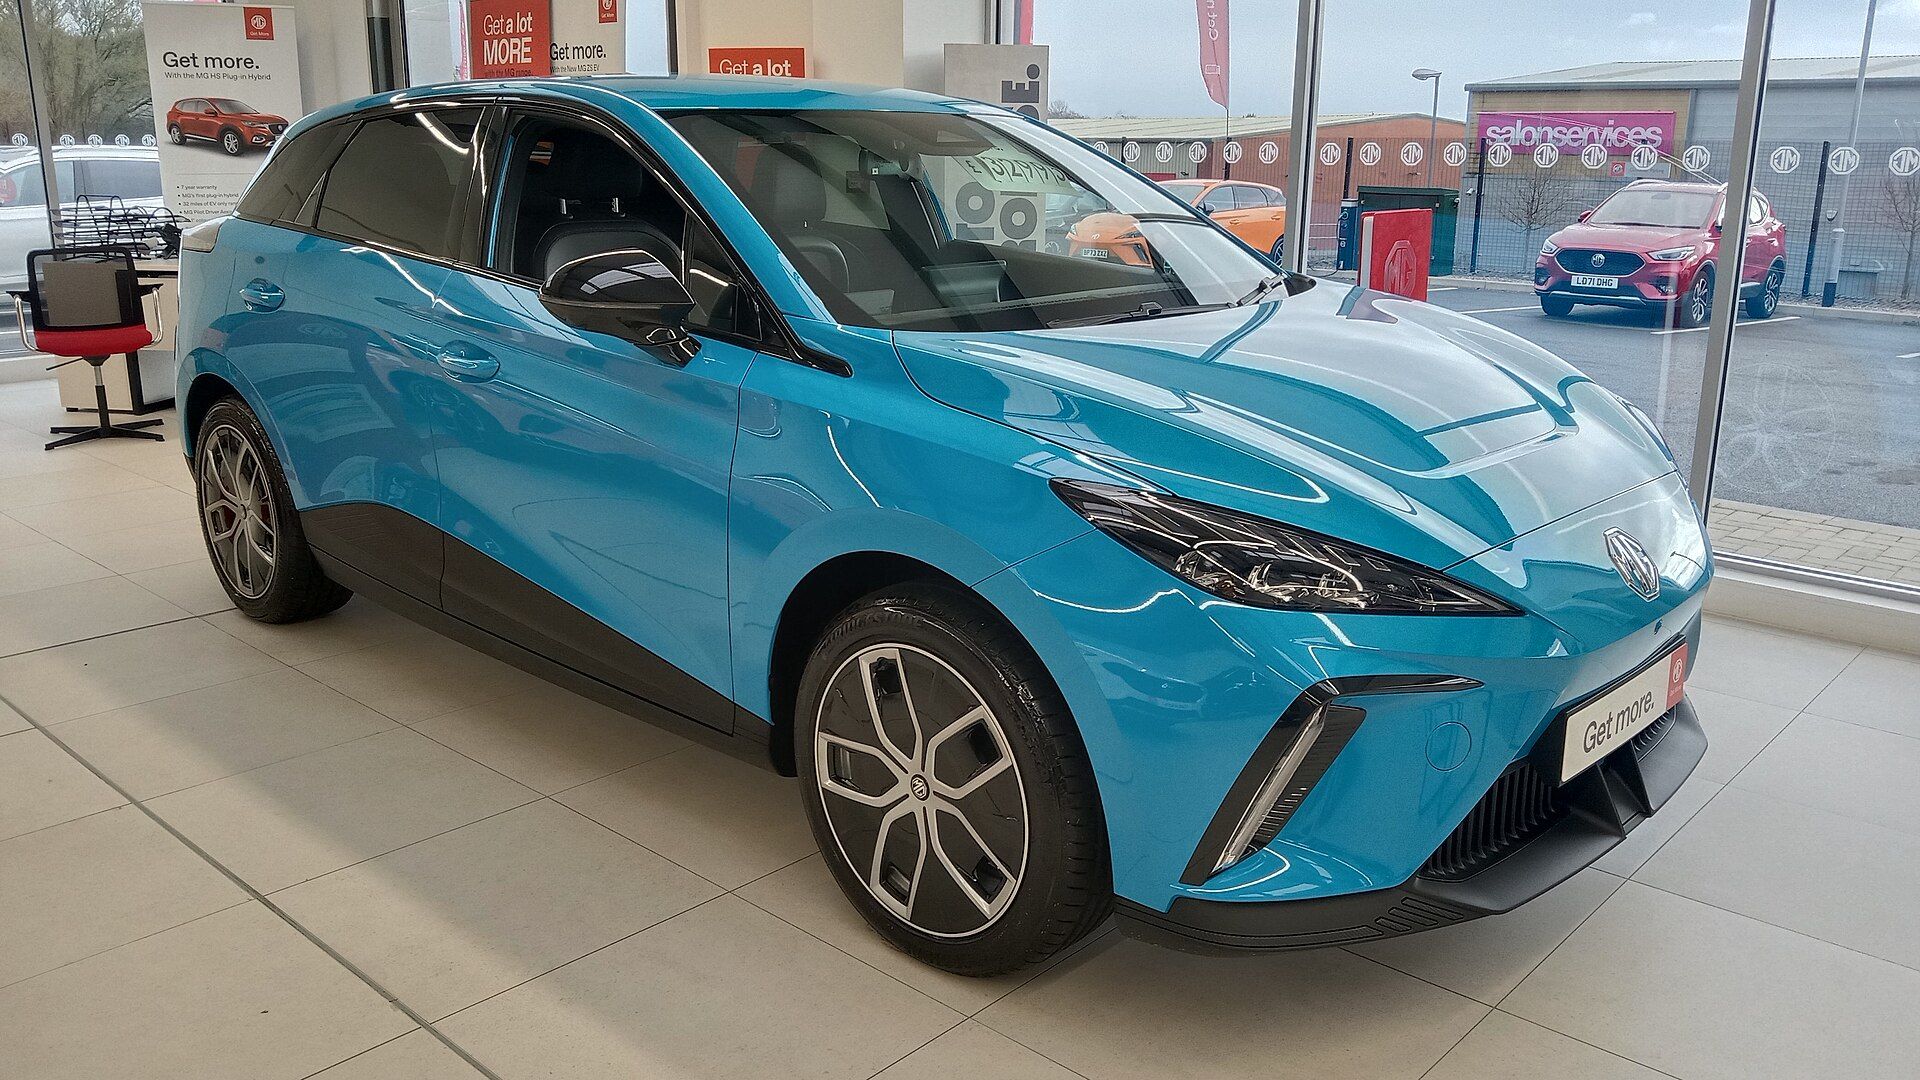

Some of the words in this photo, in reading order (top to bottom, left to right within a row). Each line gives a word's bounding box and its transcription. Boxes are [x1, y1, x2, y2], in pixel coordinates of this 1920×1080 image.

[250, 14, 267, 30] MG
[484, 15, 506, 36] Get
[506, 18, 514, 34] a
[516, 12, 533, 33] lot
[483, 37, 532, 65] MORE
[550, 43, 569, 60] Get
[572, 44, 607, 59] more.
[163, 51, 199, 68] Get
[204, 55, 260, 70] more.
[577, 64, 587, 72] MG
[719, 59, 749, 75] Get
[752, 63, 763, 76] a
[767, 59, 791, 76] lot
[222, 73, 247, 81] Plug-in
[248, 73, 272, 81] Hybrid
[1486, 119, 1662, 148] salonservices
[1596, 278, 1613, 287] DHG
[1583, 710, 1613, 754] Get
[1615, 691, 1655, 734] more.
